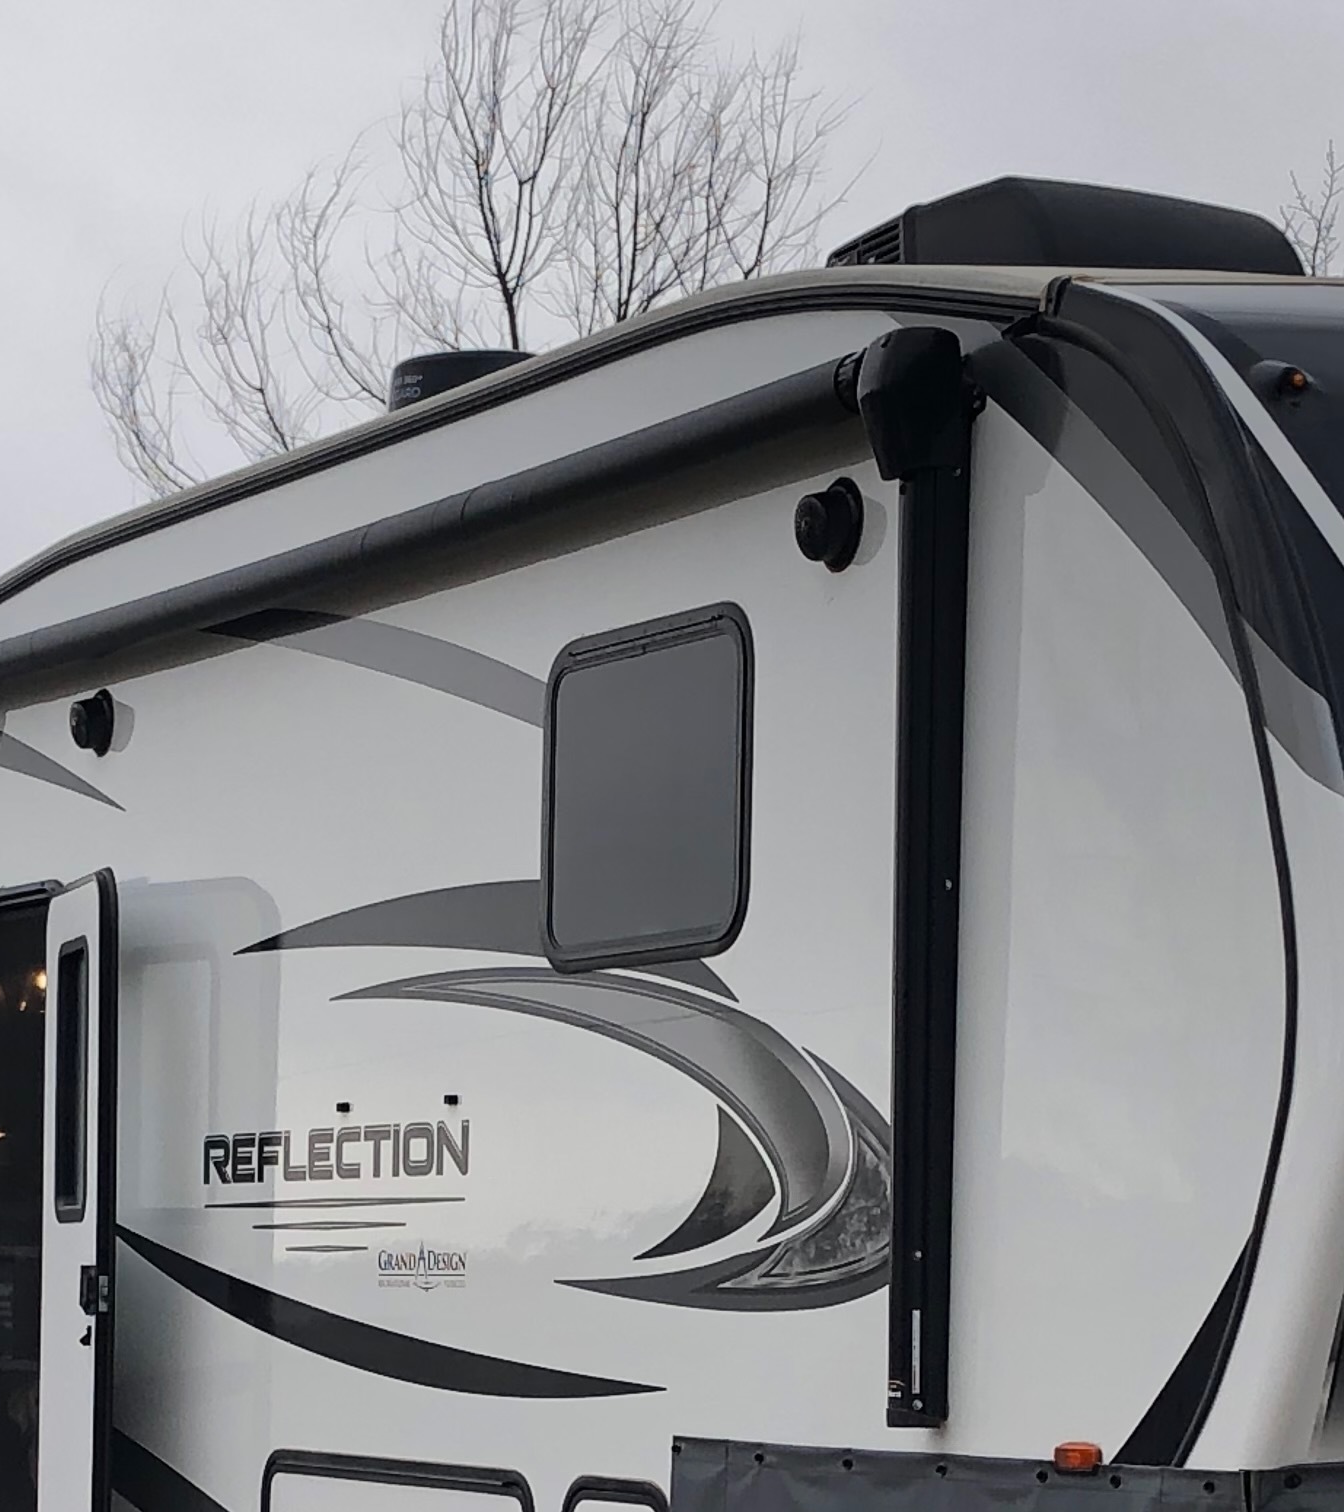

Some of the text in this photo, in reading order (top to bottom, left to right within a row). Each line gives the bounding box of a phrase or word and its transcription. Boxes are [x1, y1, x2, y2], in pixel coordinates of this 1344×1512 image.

[203, 1119, 469, 1184] REFLECTION
[378, 1249, 467, 1270] GRAND DESIGN
